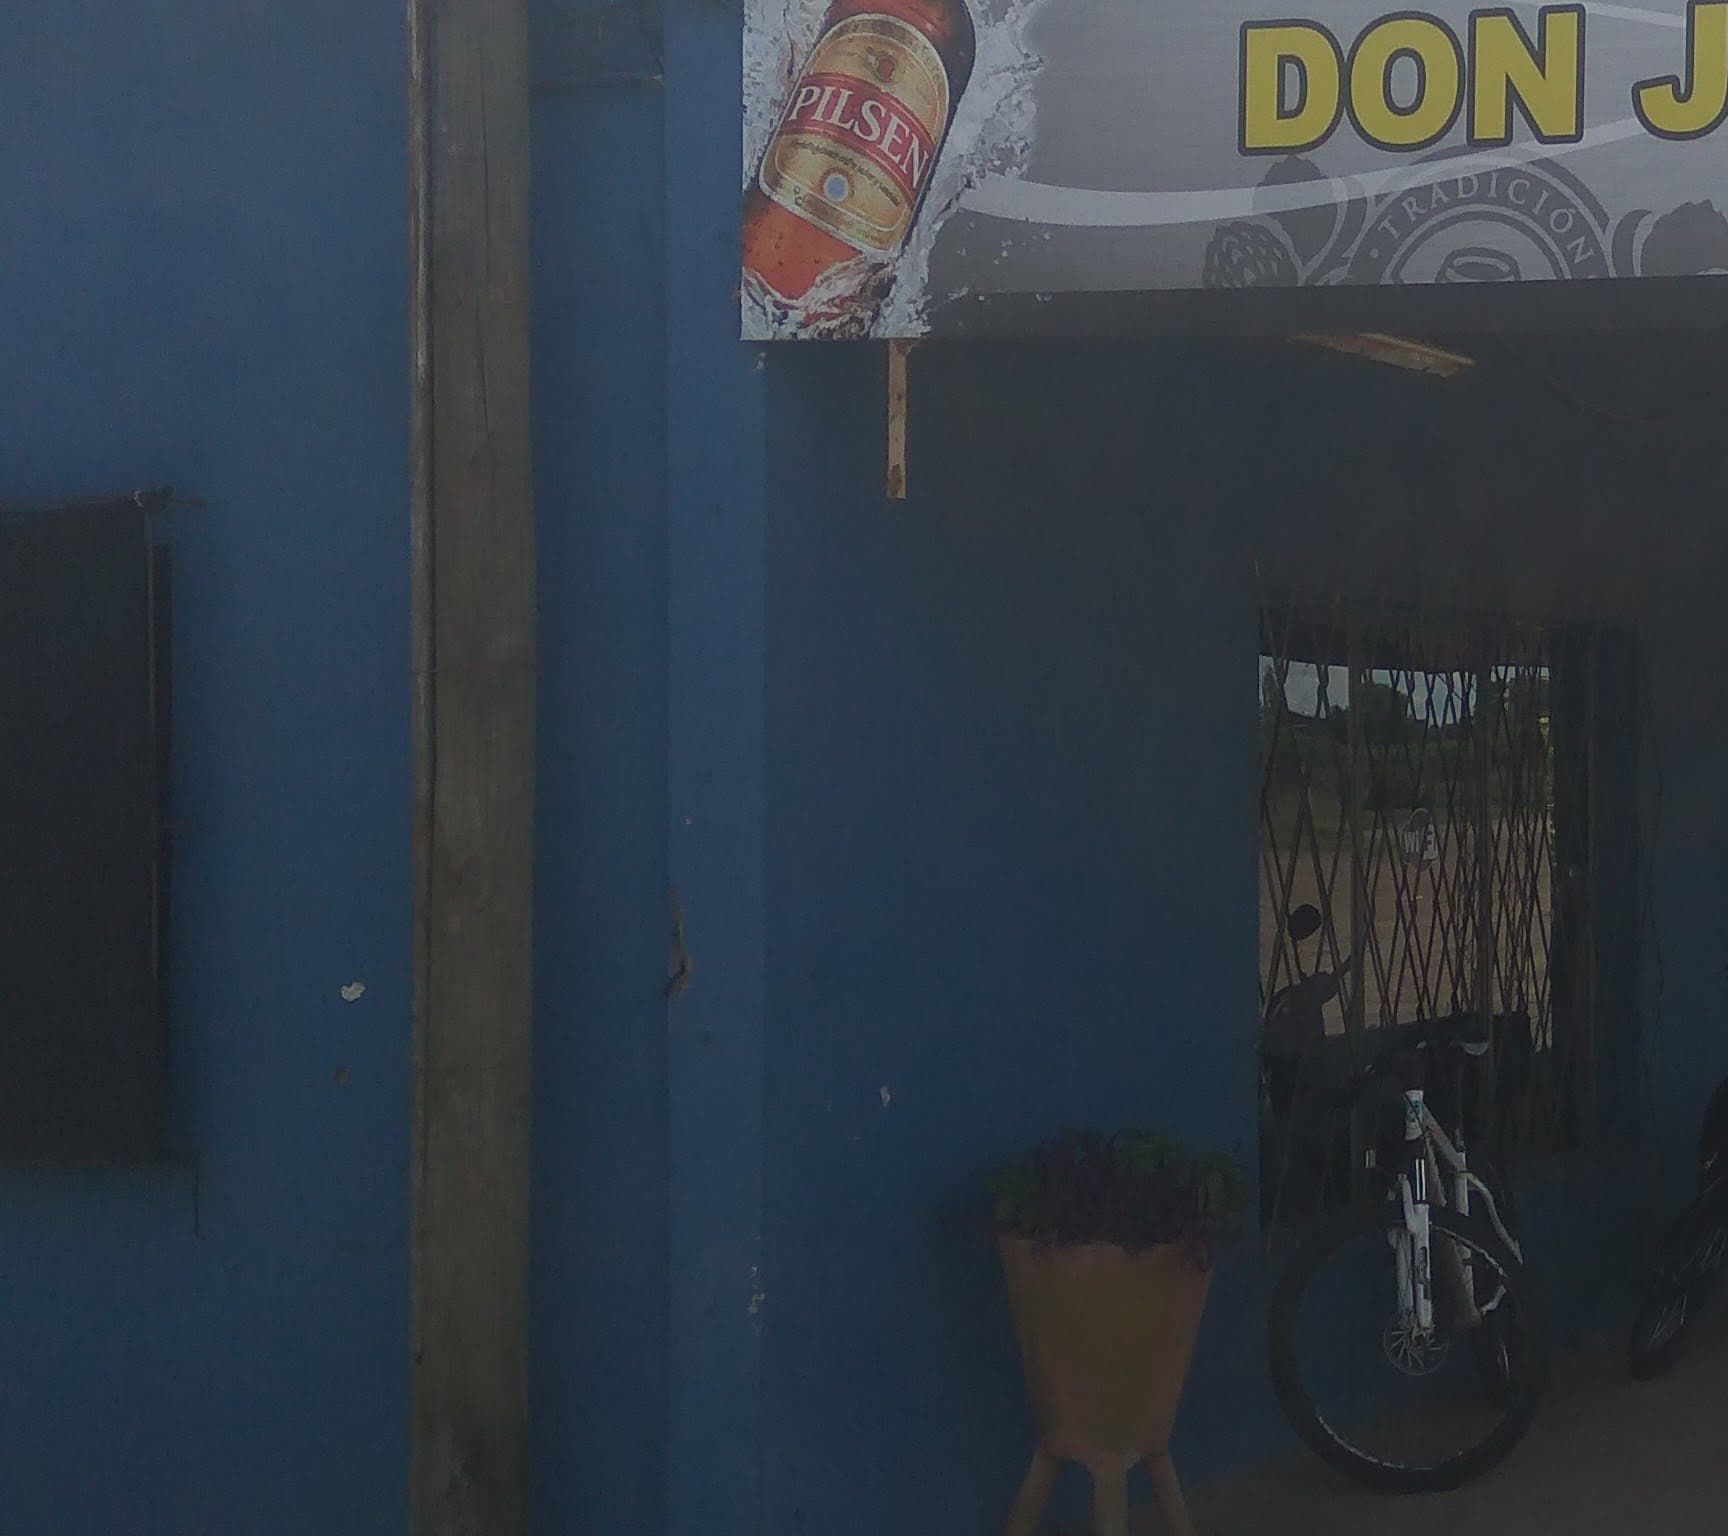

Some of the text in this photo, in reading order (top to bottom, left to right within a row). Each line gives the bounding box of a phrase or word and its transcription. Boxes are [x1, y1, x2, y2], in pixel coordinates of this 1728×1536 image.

[1239, 5, 1586, 156] DON
[787, 85, 930, 190] PILSEN
[1378, 172, 1595, 265] TRADICIÓN
